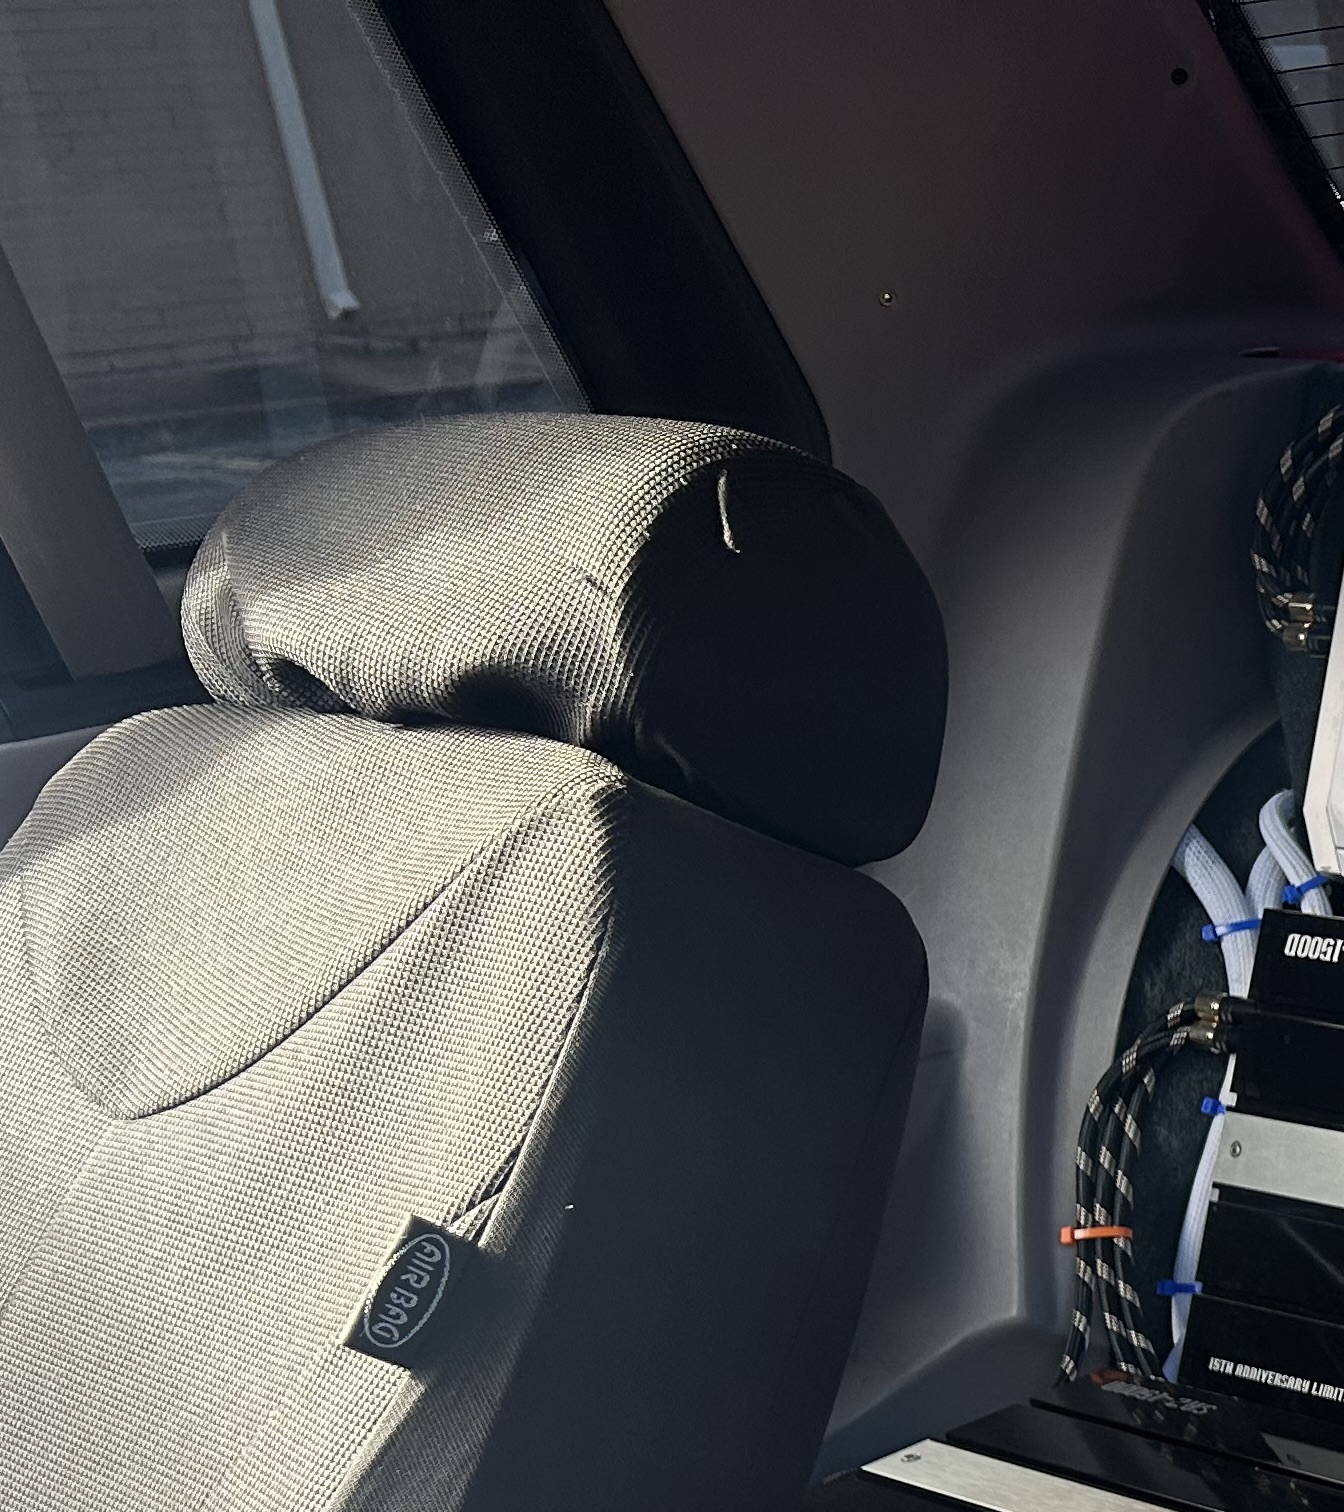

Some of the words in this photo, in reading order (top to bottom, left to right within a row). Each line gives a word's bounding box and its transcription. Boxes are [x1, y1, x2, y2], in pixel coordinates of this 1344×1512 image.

[400, 1241, 442, 1290] AIR
[372, 1286, 419, 1342] BAG
[1209, 1356, 1234, 1376] 15TH
[1234, 1363, 1310, 1394] ANNIVERSARY
